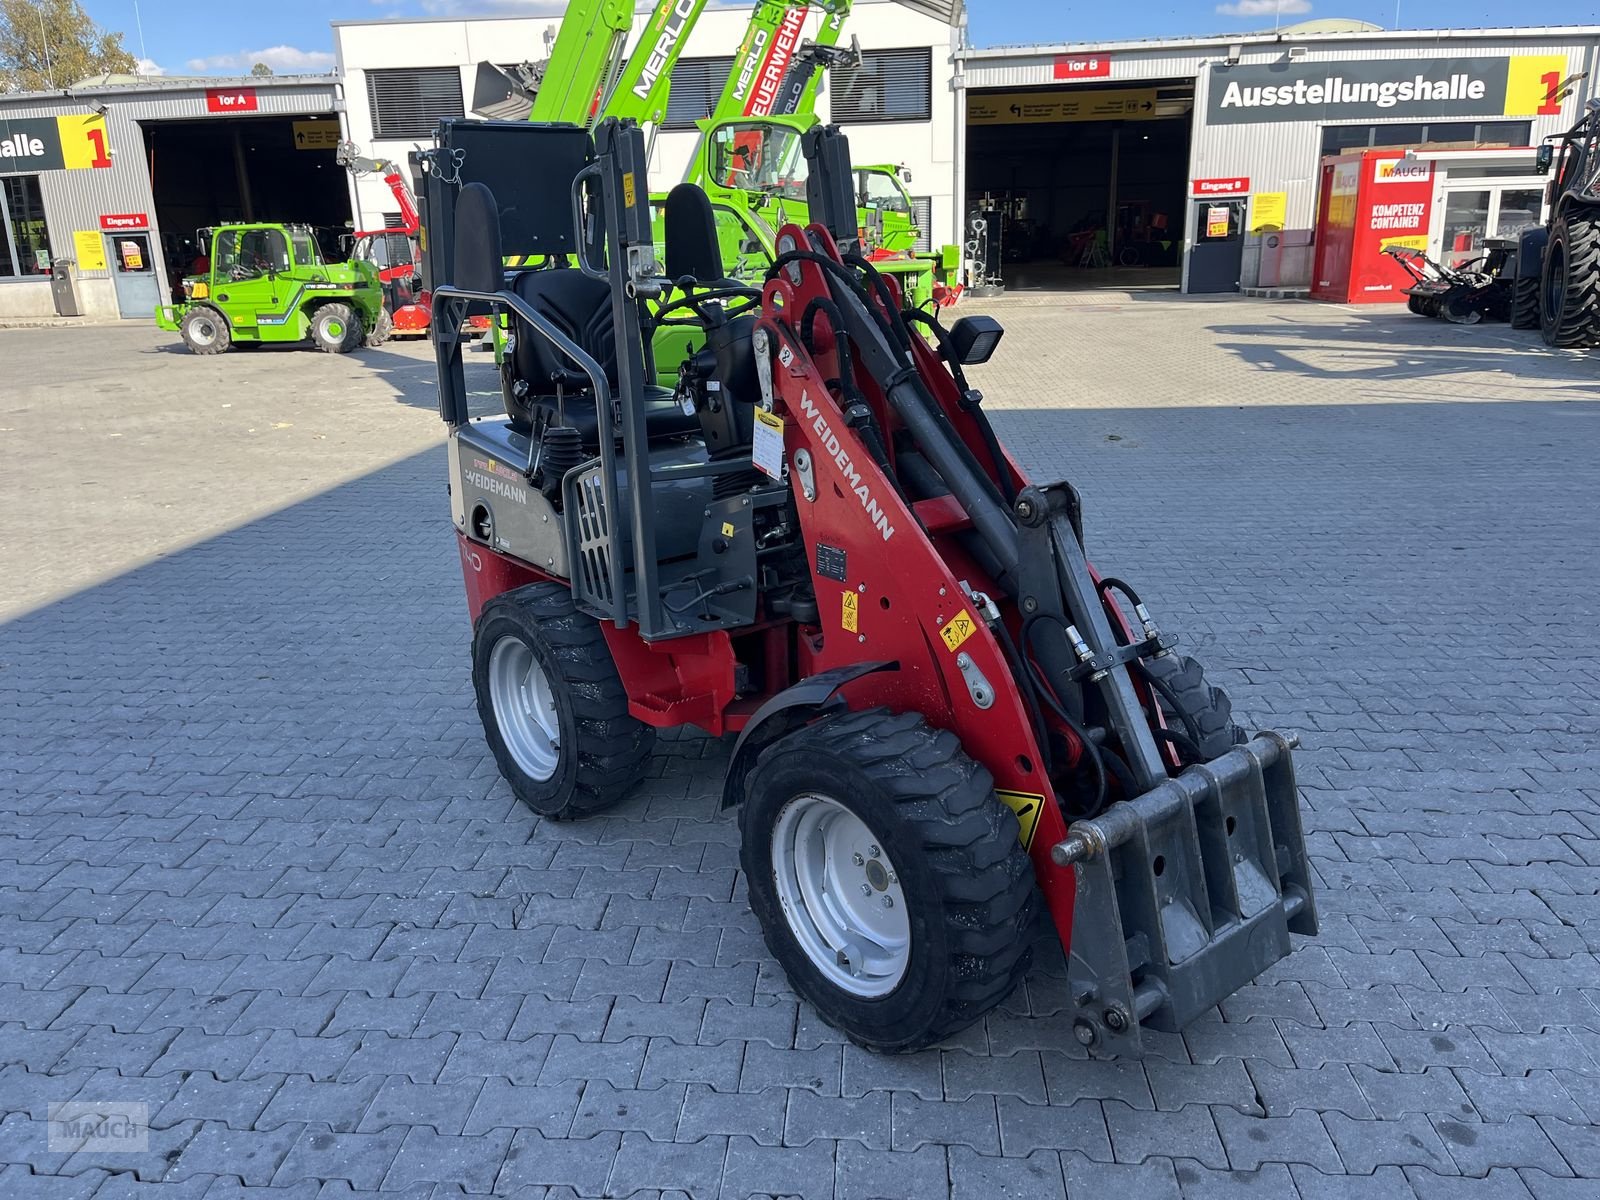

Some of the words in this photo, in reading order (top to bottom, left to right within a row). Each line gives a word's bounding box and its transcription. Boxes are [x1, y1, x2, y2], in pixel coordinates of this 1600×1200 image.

[632, 0, 696, 99] MERLO
[732, 29, 768, 101] MERLO
[750, 6, 804, 117] EUERWEHR
[1067, 60, 1086, 71] Tor
[1089, 59, 1098, 71] B
[218, 95, 234, 106] Tor
[237, 94, 246, 105] A
[783, 82, 802, 114] RLO
[1220, 73, 1486, 108] Ausstellungshalle
[1537, 71, 1562, 115] 1
[0, 133, 45, 158] alle
[87, 128, 112, 169] 1
[1201, 182, 1233, 191] Eingang
[1235, 181, 1241, 189] B
[1383, 167, 1426, 178] MAUCH
[106, 217, 135, 226] Eingang
[135, 216, 141, 225] A
[1370, 216, 1420, 229] CONTAINER
[1371, 203, 1425, 217] KOMPETENZ
[800, 389, 896, 542] WEIDEMANN
[465, 469, 527, 505] WEIDEMANN
